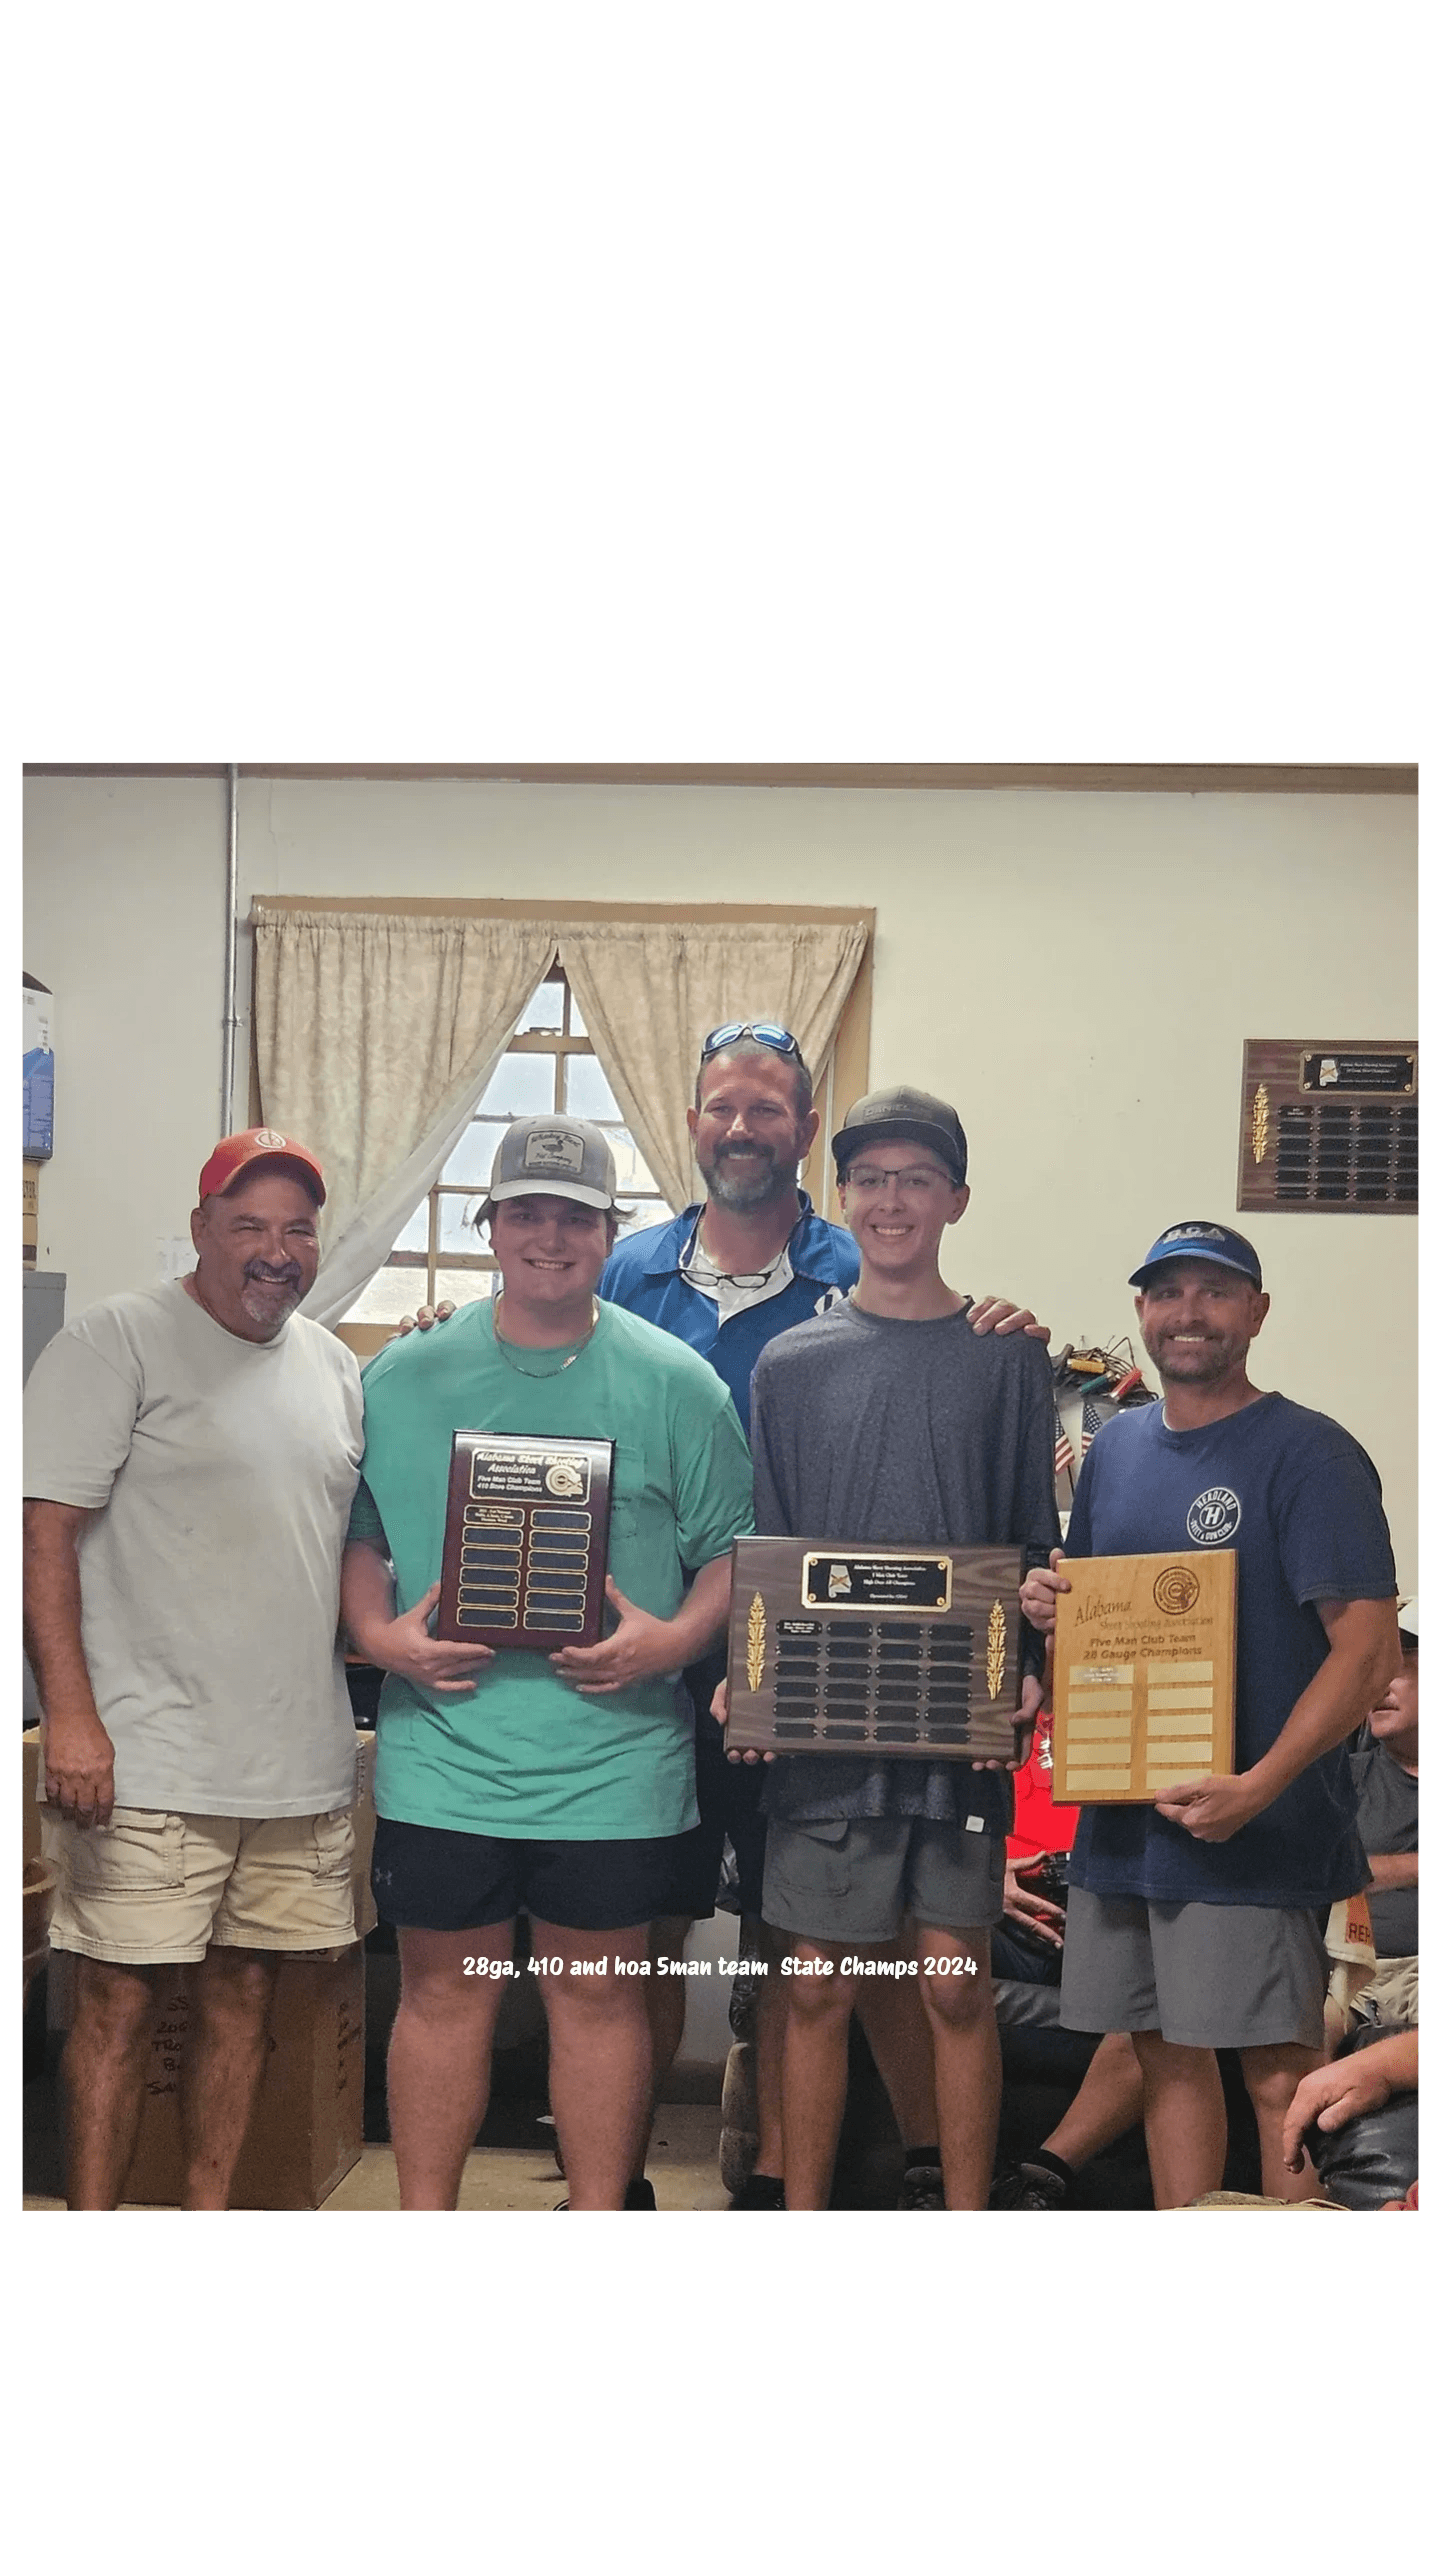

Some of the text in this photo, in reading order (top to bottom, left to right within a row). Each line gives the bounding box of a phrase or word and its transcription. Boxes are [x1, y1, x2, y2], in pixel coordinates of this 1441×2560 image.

[476, 1452, 516, 1463] Alabama
[487, 1463, 537, 1475] Association
[477, 1475, 492, 1483] Five
[524, 1478, 542, 1486] Team
[506, 1484, 543, 1493] Champions
[1195, 1490, 1237, 1510] HEADLAND
[1204, 1506, 1221, 1525] H
[1074, 1594, 1132, 1628] Alabama
[1090, 1633, 1196, 1648] Five Man Club Team
[1083, 1646, 1203, 1661] 28 Gauge Champions
